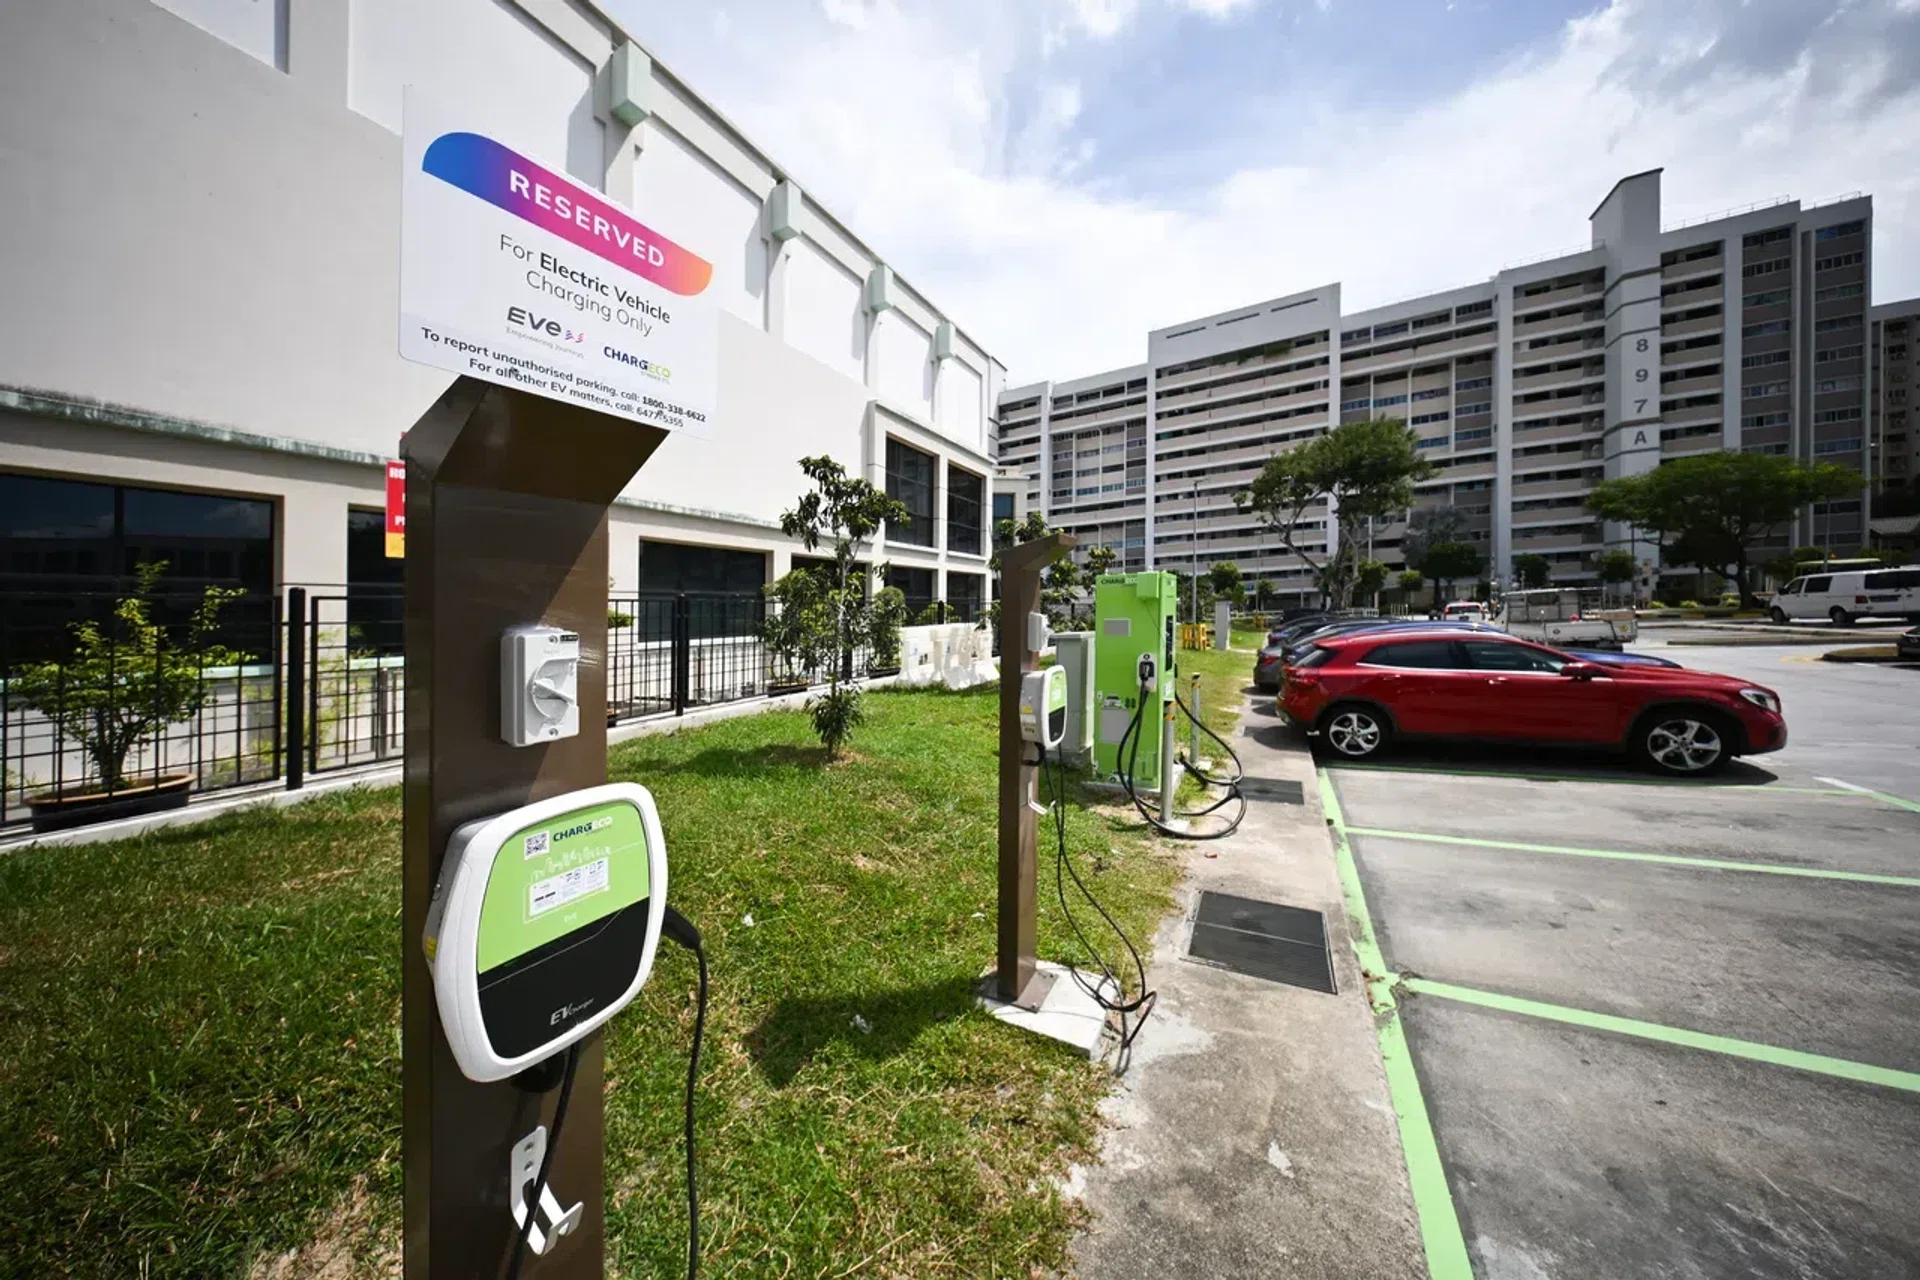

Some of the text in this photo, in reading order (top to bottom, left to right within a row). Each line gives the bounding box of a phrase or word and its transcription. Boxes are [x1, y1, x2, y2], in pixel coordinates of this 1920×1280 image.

[510, 169, 665, 267] RESERVED
[500, 234, 670, 323] For Electric Vehicle
[526, 270, 652, 337] Charging Only
[421, 327, 440, 342] To
[444, 336, 489, 357] report
[492, 351, 573, 382] unauthorised
[642, 396, 706, 422] 1800-338-6622
[469, 358, 491, 373] For
[496, 367, 511, 379] all
[515, 373, 548, 388] other
[550, 381, 567, 393] EV
